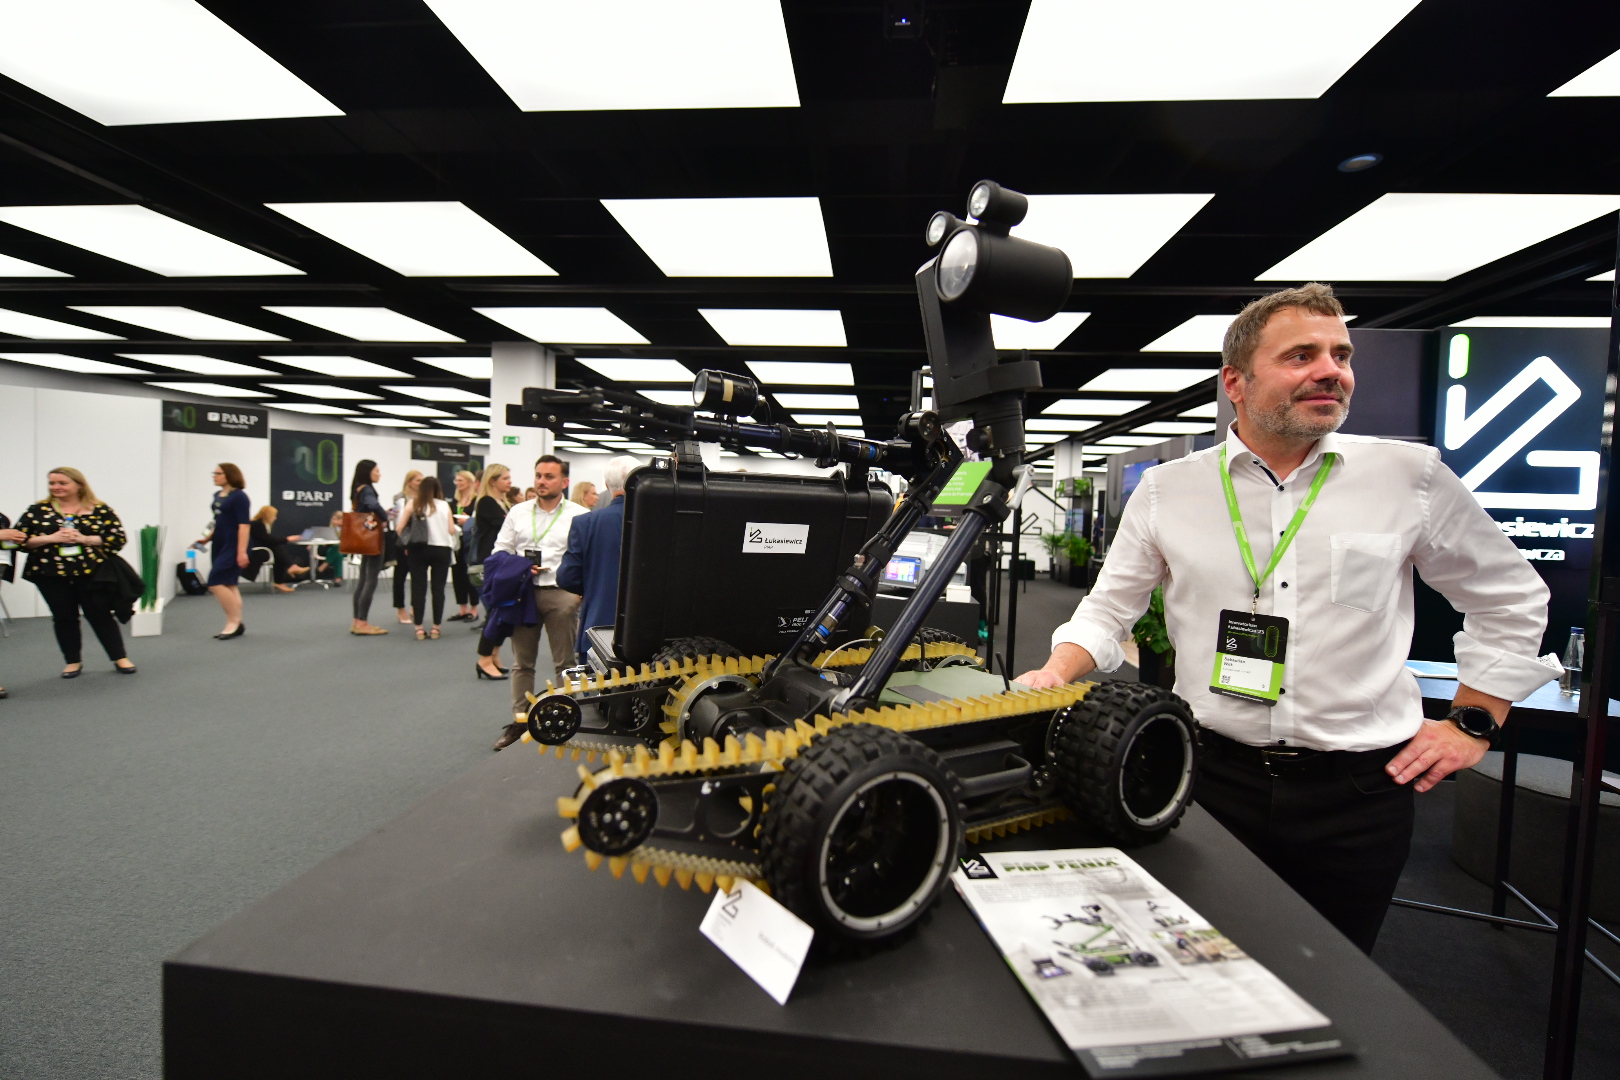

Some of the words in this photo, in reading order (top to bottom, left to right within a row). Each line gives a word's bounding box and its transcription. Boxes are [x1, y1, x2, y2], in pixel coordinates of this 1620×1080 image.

[221, 412, 259, 425] PARP
[296, 490, 333, 501] PARP
[765, 537, 803, 545] Łukasiewicz
